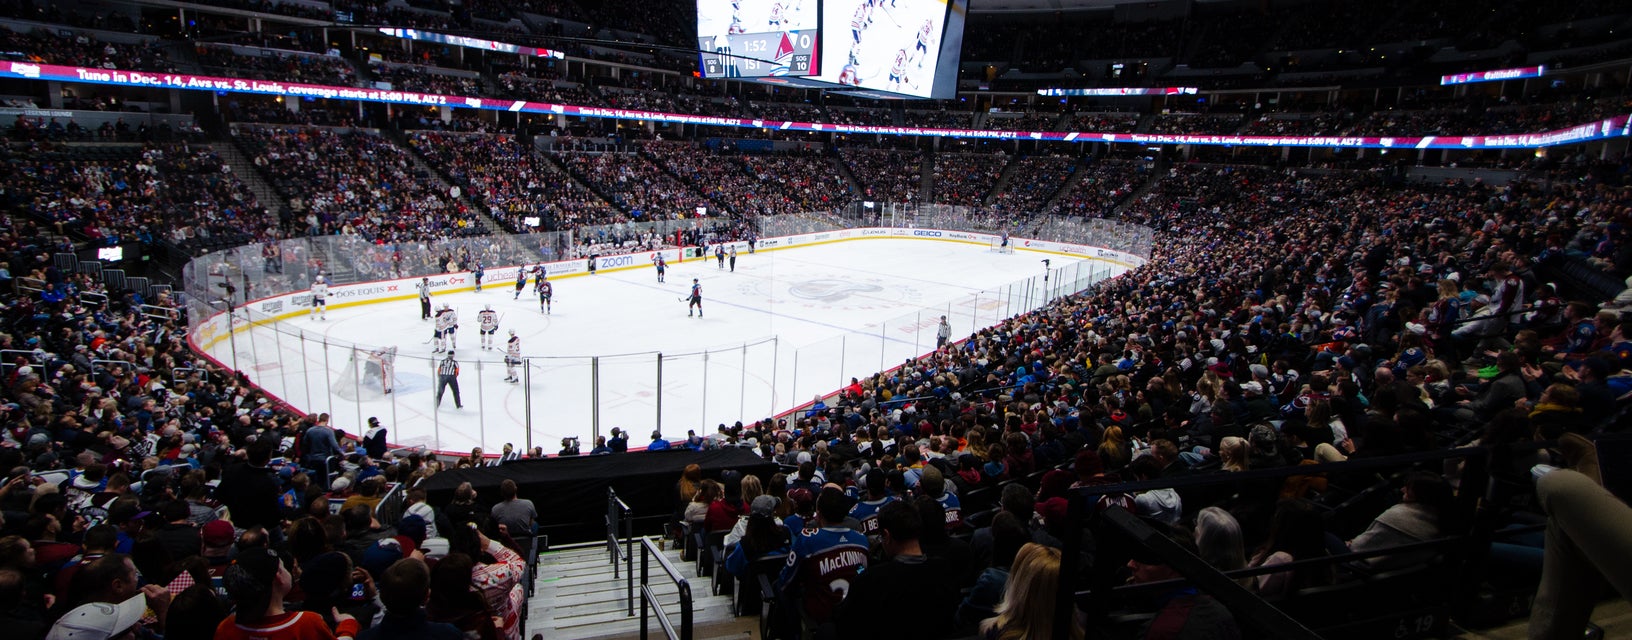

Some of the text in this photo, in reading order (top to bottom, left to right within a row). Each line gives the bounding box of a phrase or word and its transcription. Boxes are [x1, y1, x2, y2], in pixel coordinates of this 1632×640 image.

[705, 40, 710, 51] 1
[744, 40, 767, 52] 1:52
[800, 34, 811, 49] 0
[710, 65, 715, 73] 8
[745, 60, 761, 70] 1ST
[796, 63, 807, 71] 10
[76, 69, 446, 104] Tune in Dec. 14, Avs vs. St. Louis, coverage starts at 5:00 PM, ALT 2
[1222, 136, 1242, 144] Louis,
[1243, 138, 1279, 146] coverage
[1325, 138, 1340, 146] PM,
[602, 255, 633, 268] zoom
[487, 269, 517, 282] ucheal
[336, 290, 355, 299] DOS
[357, 286, 385, 296] EQUIS
[482, 316, 492, 324] 29
